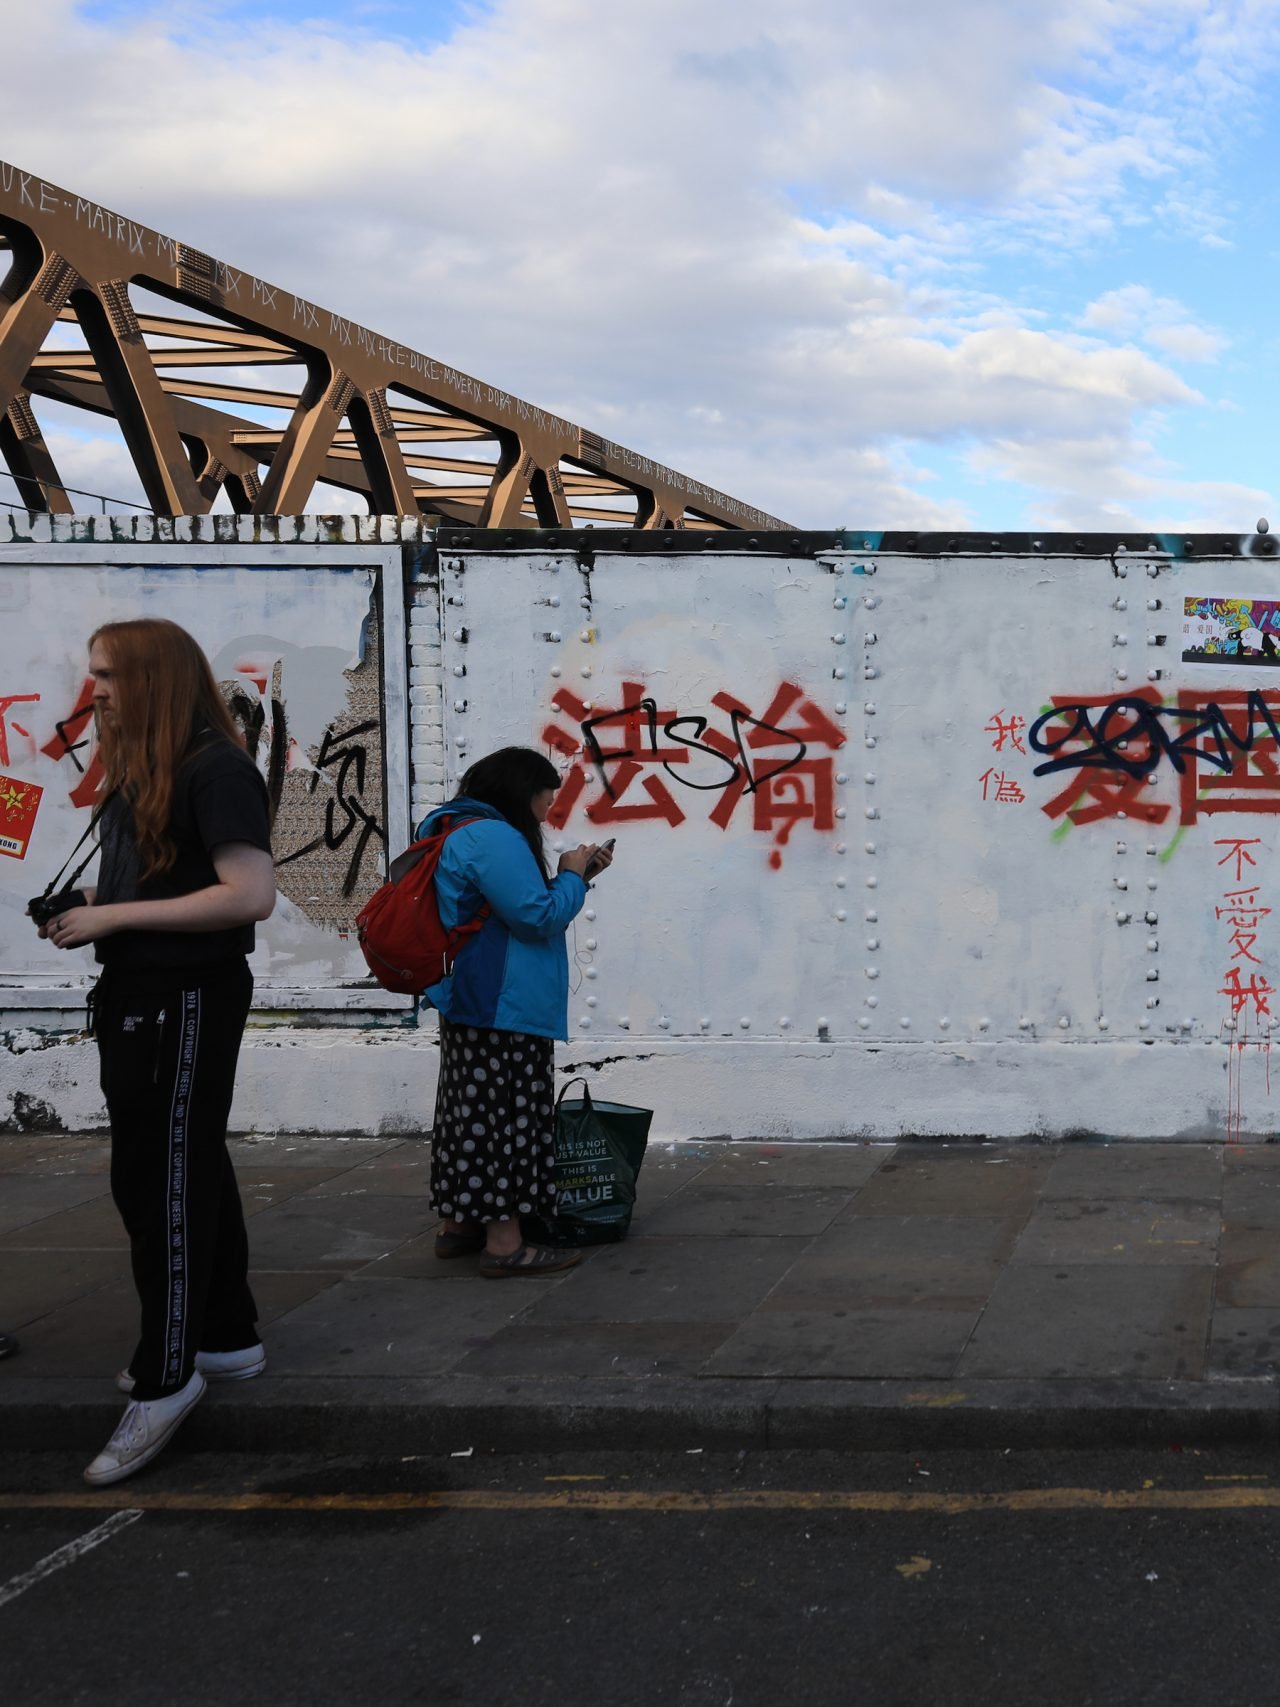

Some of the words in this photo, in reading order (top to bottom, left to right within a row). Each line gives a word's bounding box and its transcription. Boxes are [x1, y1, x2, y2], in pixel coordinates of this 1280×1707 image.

[542, 681, 848, 831] 法治
[183, 1019, 195, 1065] COPYRIGHT
[178, 1070, 190, 1099] DIESEL
[575, 1141, 584, 1150] IS
[586, 1139, 608, 1149] NOT
[576, 1147, 607, 1158] VALUE
[173, 1152, 183, 1194] COPYRIGHT
[561, 1166, 585, 1176] THIS
[588, 1164, 597, 1173] IS
[172, 1200, 181, 1228] DIESEL
